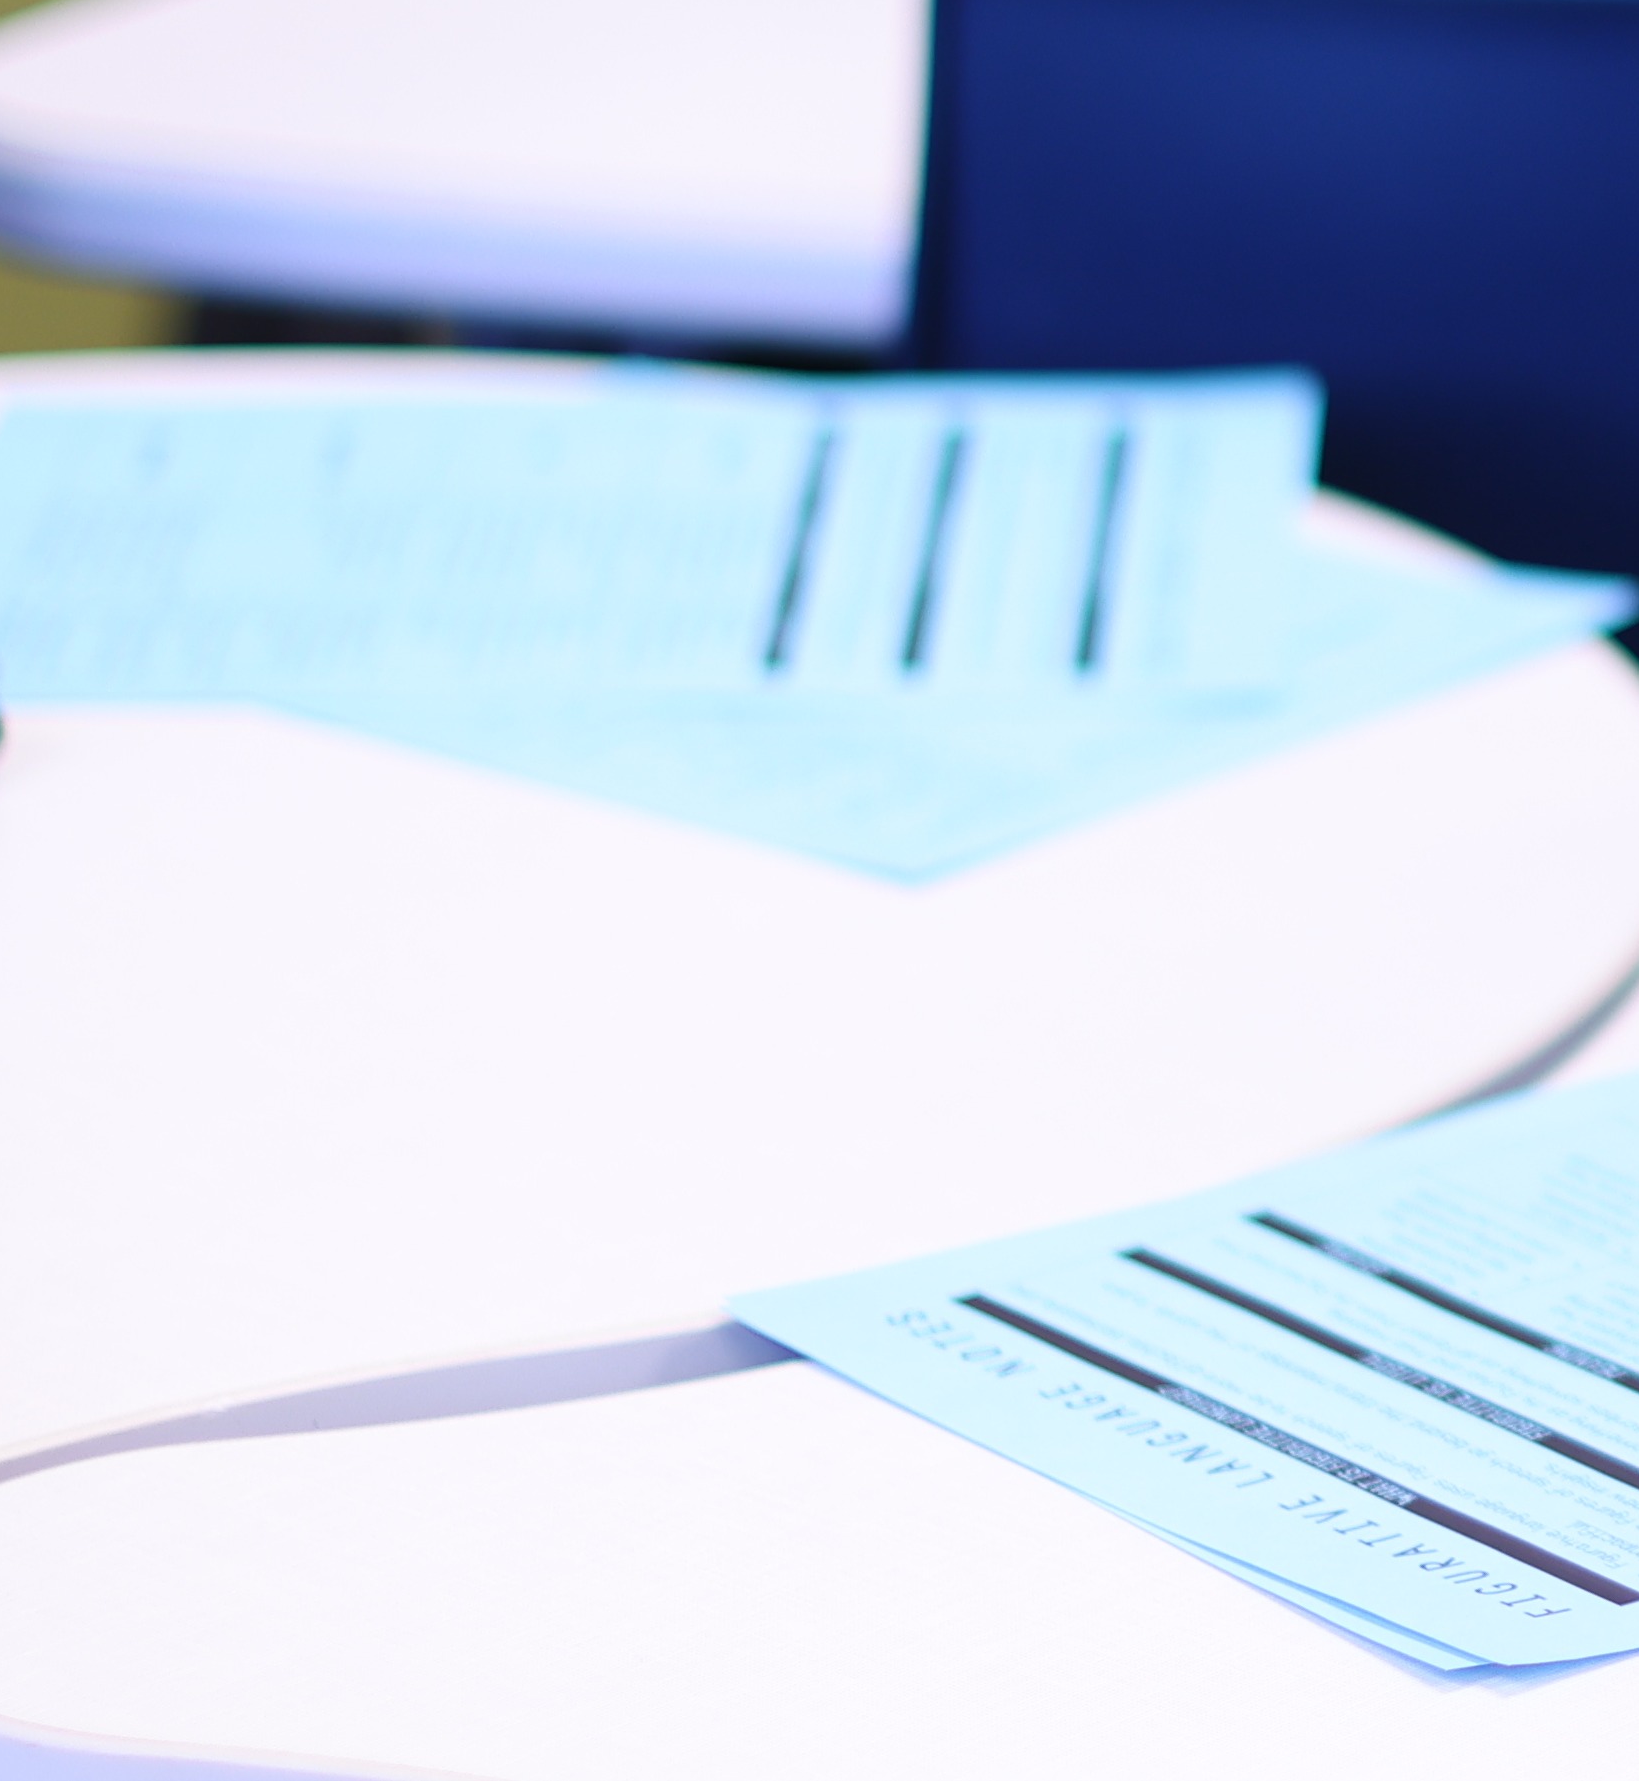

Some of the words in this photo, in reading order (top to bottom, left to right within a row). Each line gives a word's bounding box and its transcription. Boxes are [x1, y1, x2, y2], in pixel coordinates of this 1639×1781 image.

[885, 1308, 1033, 1380] NOTES
[1415, 1381, 1458, 1397] VS
[1039, 1381, 1275, 1490] LANGUAGE
[1443, 1393, 1555, 1440] FIGURATIVE
[1241, 1425, 1350, 1472] FIGURATIVE
[1330, 1466, 1373, 1482] IS
[1350, 1476, 1423, 1506] WHAT
[1279, 1492, 1572, 1619] FIGURATIVE
[1537, 1528, 1635, 1569] Figurative
